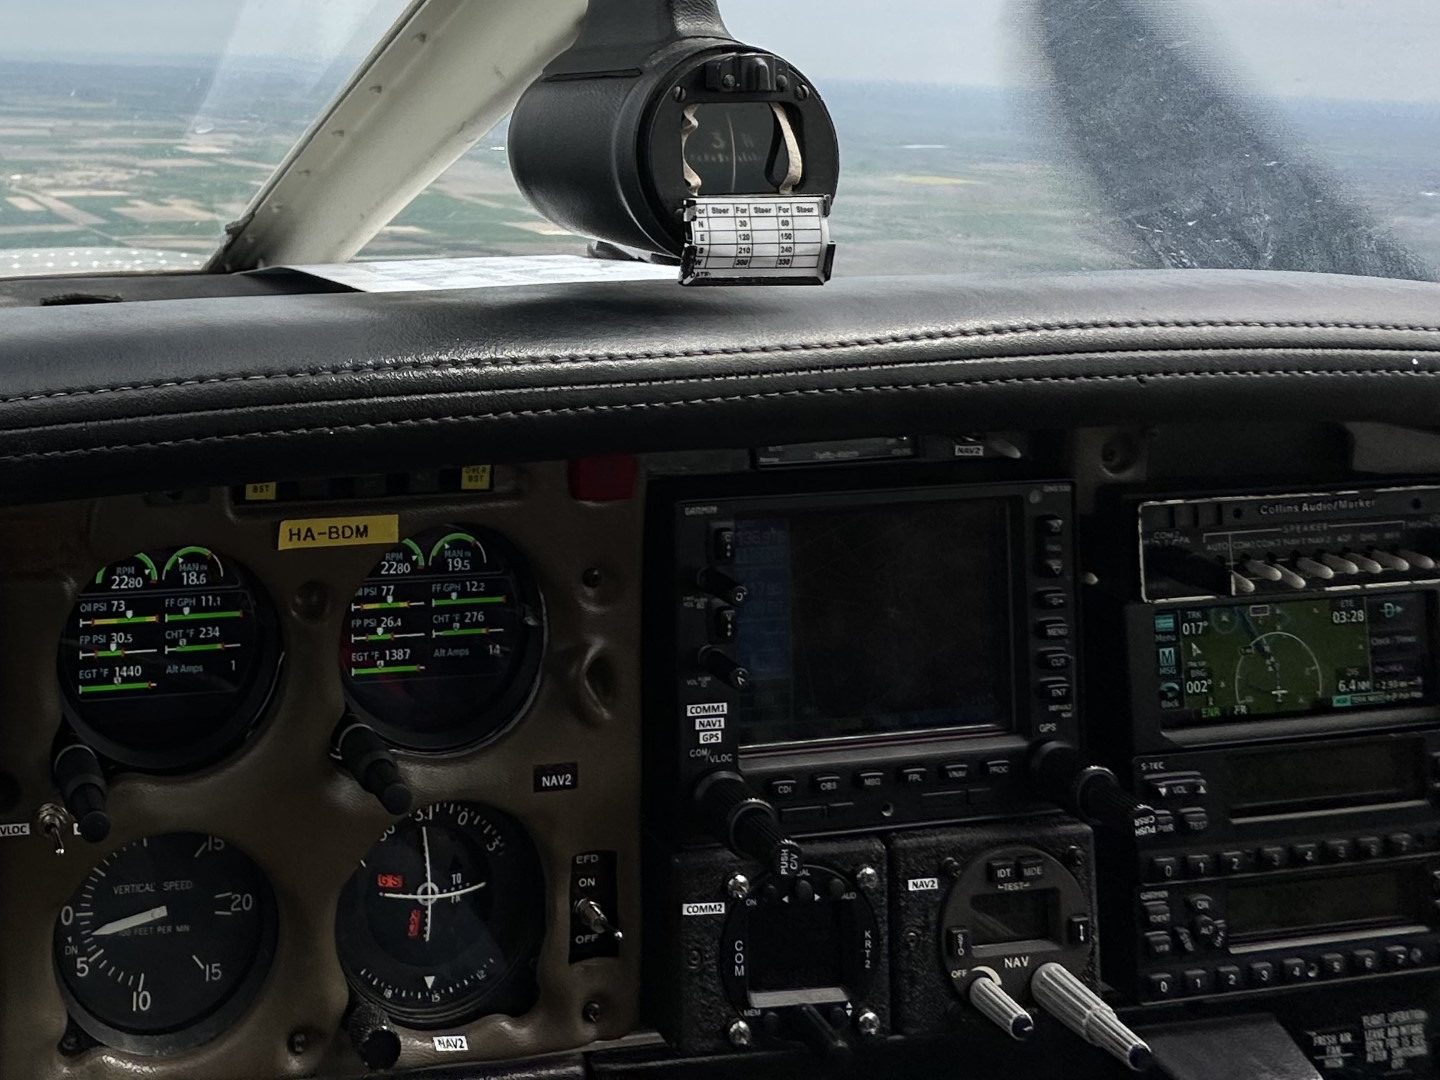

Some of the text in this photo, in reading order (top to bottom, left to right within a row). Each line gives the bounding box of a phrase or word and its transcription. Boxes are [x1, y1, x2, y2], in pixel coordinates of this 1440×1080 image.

[684, 506, 718, 516] GARMIN
[1260, 499, 1376, 514] Collins Audio/Marker
[288, 524, 369, 542] HA-BDM
[1282, 522, 1328, 534] SPEAKER
[115, 566, 135, 575] RPM
[380, 561, 410, 574] 2280
[448, 558, 470, 571] 19.5
[111, 575, 143, 589] 2280
[181, 572, 207, 586] 18.6
[431, 581, 485, 592] FF GPH 12.2
[79, 600, 126, 613] Oil PSI 73
[165, 595, 221, 607] FF GPH 11.1
[432, 611, 485, 623] CHT °F 276
[1186, 611, 1202, 619] TRK
[1332, 609, 1365, 624] 03:28
[351, 616, 402, 628] FP PSI 26.4
[1182, 621, 1208, 635] 017°
[79, 632, 133, 644] FP PSI 30.5
[165, 626, 220, 639] CHT °F 234
[1047, 628, 1067, 636] MENU
[351, 648, 411, 662] EGT °F 1387
[1051, 658, 1065, 666] CLR
[78, 665, 142, 679] EGT °F 1440
[1051, 688, 1067, 697] ENT
[1186, 679, 1212, 694] 002°
[690, 704, 725, 715] COMM1
[698, 720, 722, 728] NAV1
[1039, 723, 1056, 732] GPS
[702, 733, 719, 742] GPS
[1141, 762, 1165, 770] S-TEC
[541, 774, 572, 787] NAV2
[820, 782, 837, 790] OBS
[778, 786, 792, 794] CDI
[1173, 786, 1188, 794] VOL
[0, 825, 26, 835] VLOC
[207, 836, 224, 852] 15
[575, 855, 599, 864] EFD
[781, 848, 789, 875] PUSH
[1232, 858, 1239, 870] 2
[1165, 865, 1172, 877] 0
[1199, 862, 1204, 873] 1
[113, 880, 193, 895] VERTICAL SPEED
[578, 877, 595, 888] ON
[912, 880, 935, 889] NAV2
[230, 894, 252, 912] 20
[686, 904, 722, 914] COMM2
[1196, 900, 1209, 909] ON
[61, 906, 74, 926] 0
[575, 934, 599, 945] OFF
[65, 945, 78, 955] DN
[864, 930, 872, 969] KRT2
[735, 940, 744, 976] COM
[1004, 957, 1029, 968] NAV
[76, 957, 89, 978] 5
[206, 963, 222, 982] 15
[951, 970, 967, 978] OFF
[1160, 981, 1168, 993] 0
[132, 991, 151, 1012] 10
[438, 1038, 464, 1049] NAV2
